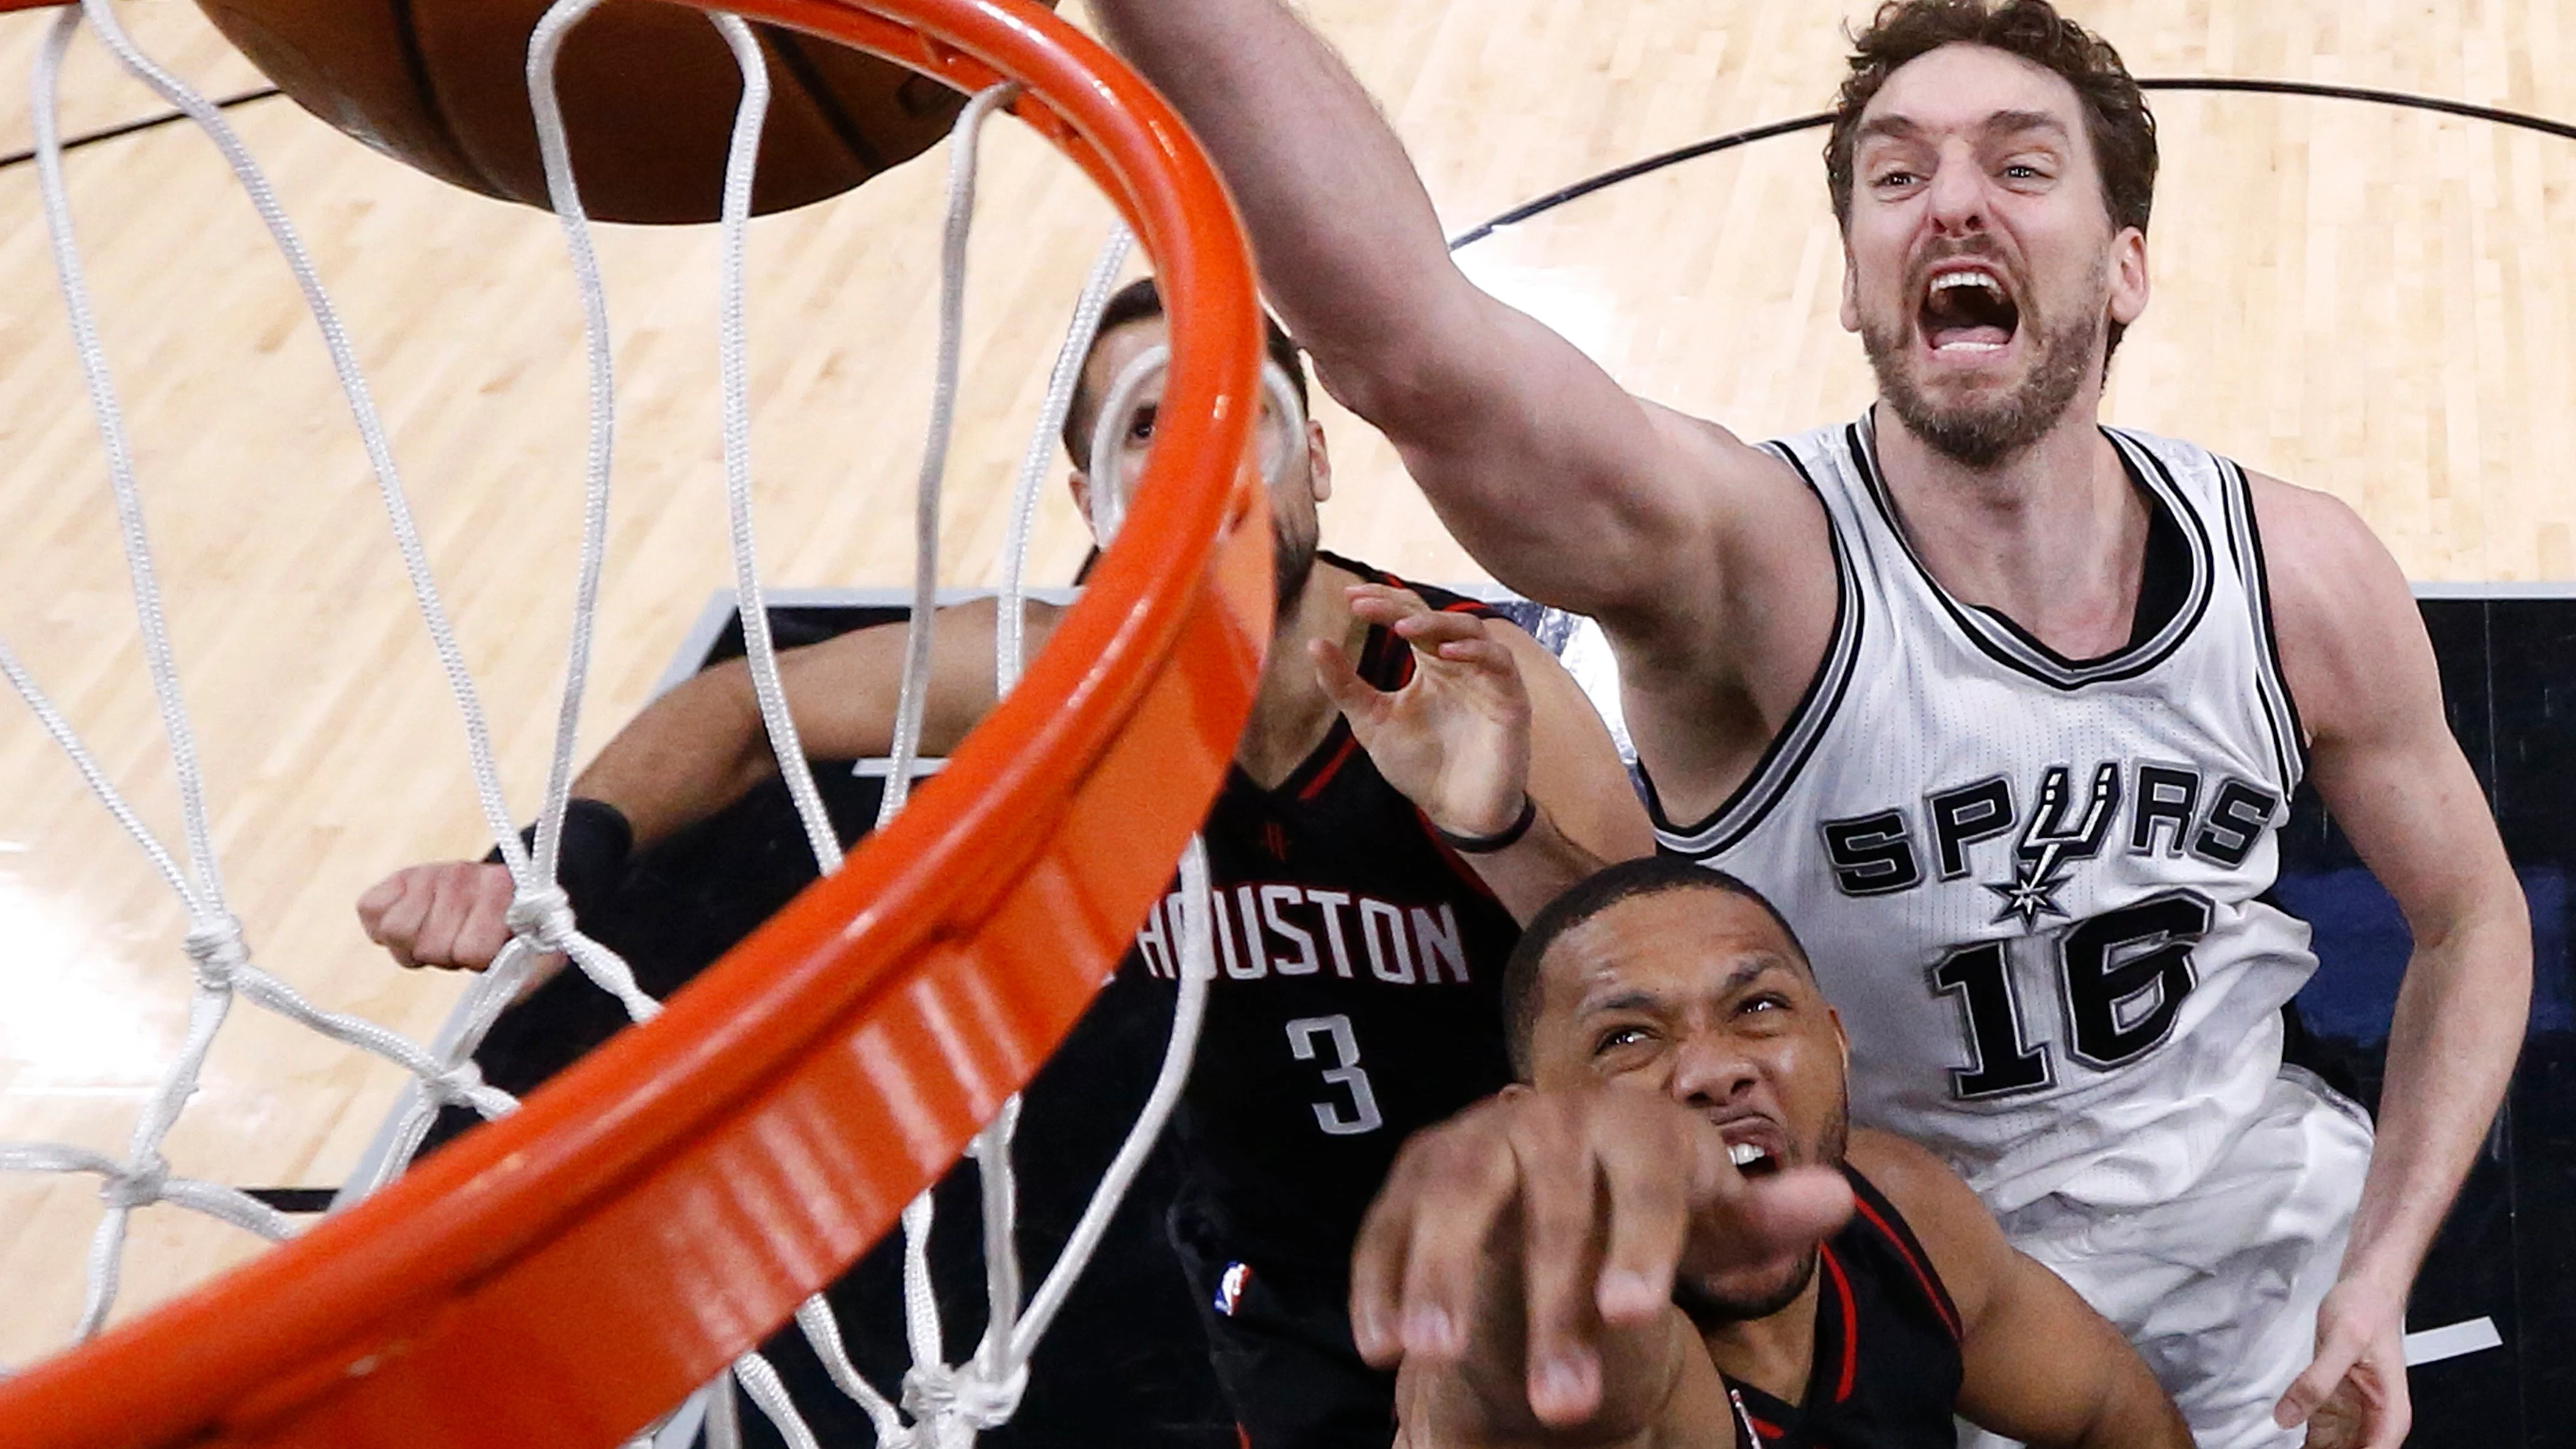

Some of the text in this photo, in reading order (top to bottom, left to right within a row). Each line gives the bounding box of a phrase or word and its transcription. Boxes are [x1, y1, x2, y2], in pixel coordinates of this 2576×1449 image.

[1819, 757, 2282, 897] SPURS
[1925, 886, 2216, 1100] 16
[1286, 1014, 1383, 1135] 3
